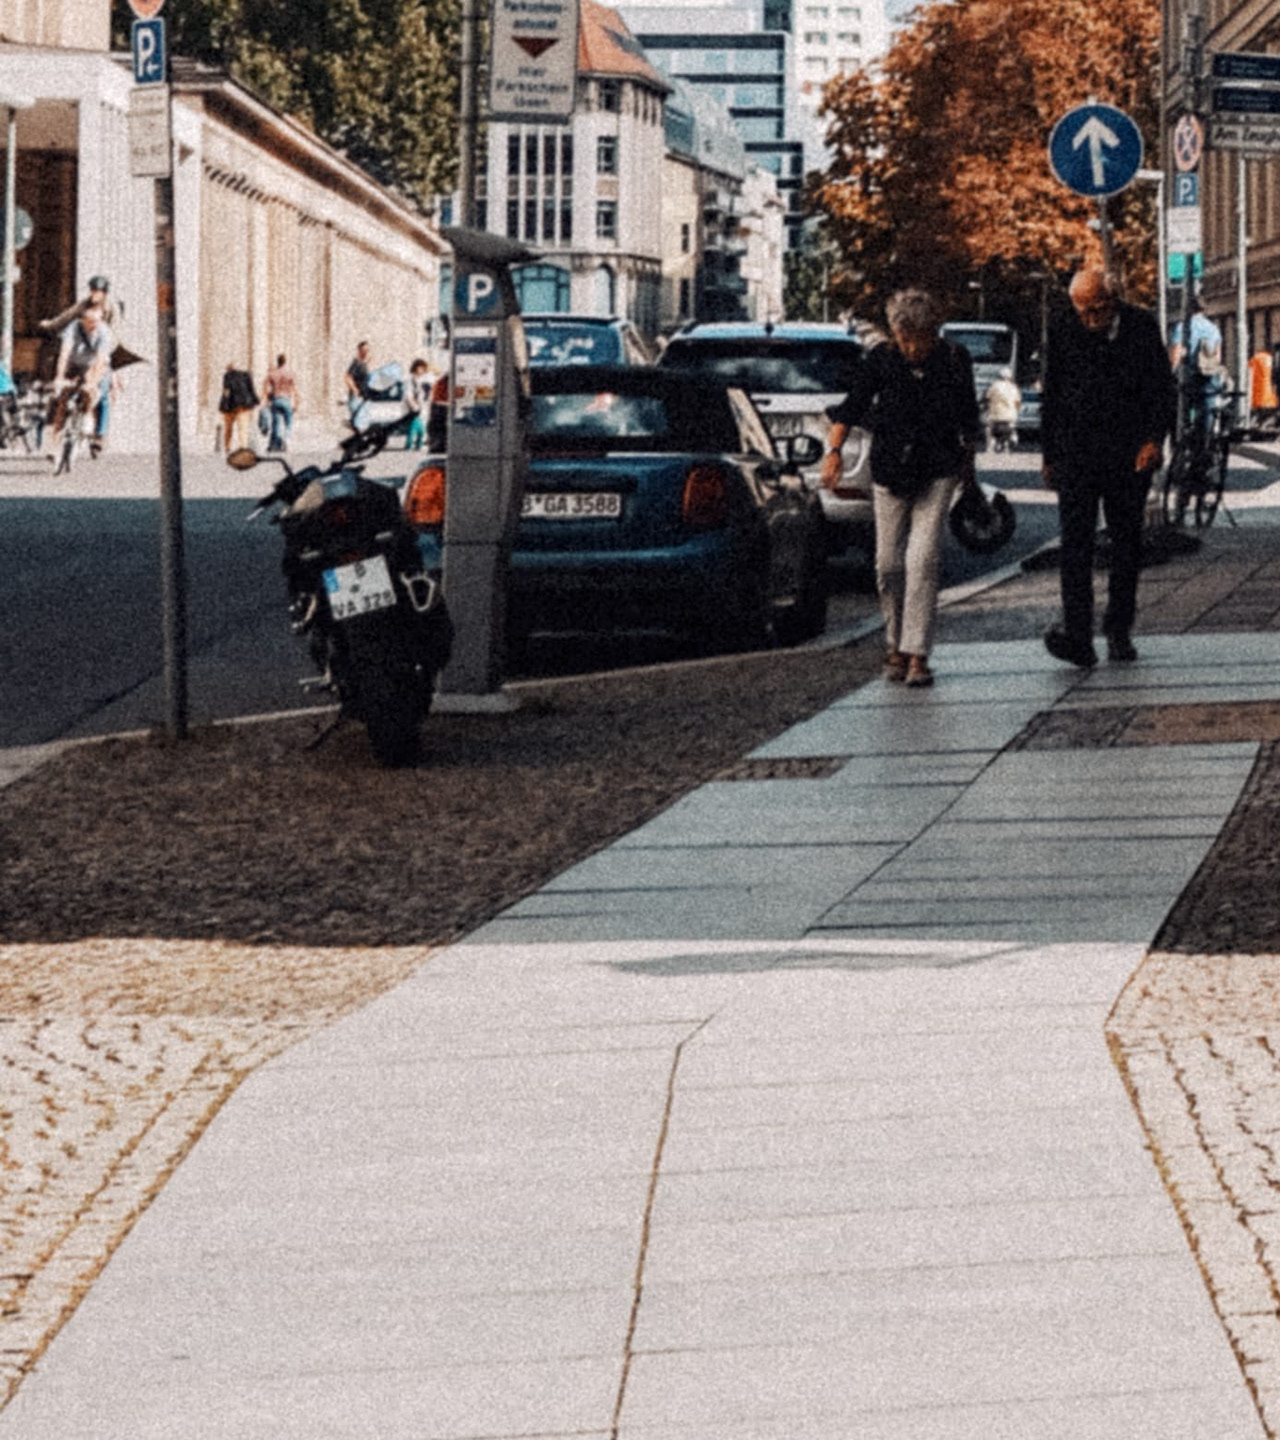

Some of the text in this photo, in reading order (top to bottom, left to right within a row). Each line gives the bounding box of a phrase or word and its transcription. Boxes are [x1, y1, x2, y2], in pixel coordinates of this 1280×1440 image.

[137, 27, 155, 78] P
[518, 66, 546, 76] Hier
[496, 78, 568, 94] Parkschein
[1214, 126, 1238, 140] Am
[467, 273, 494, 313] P
